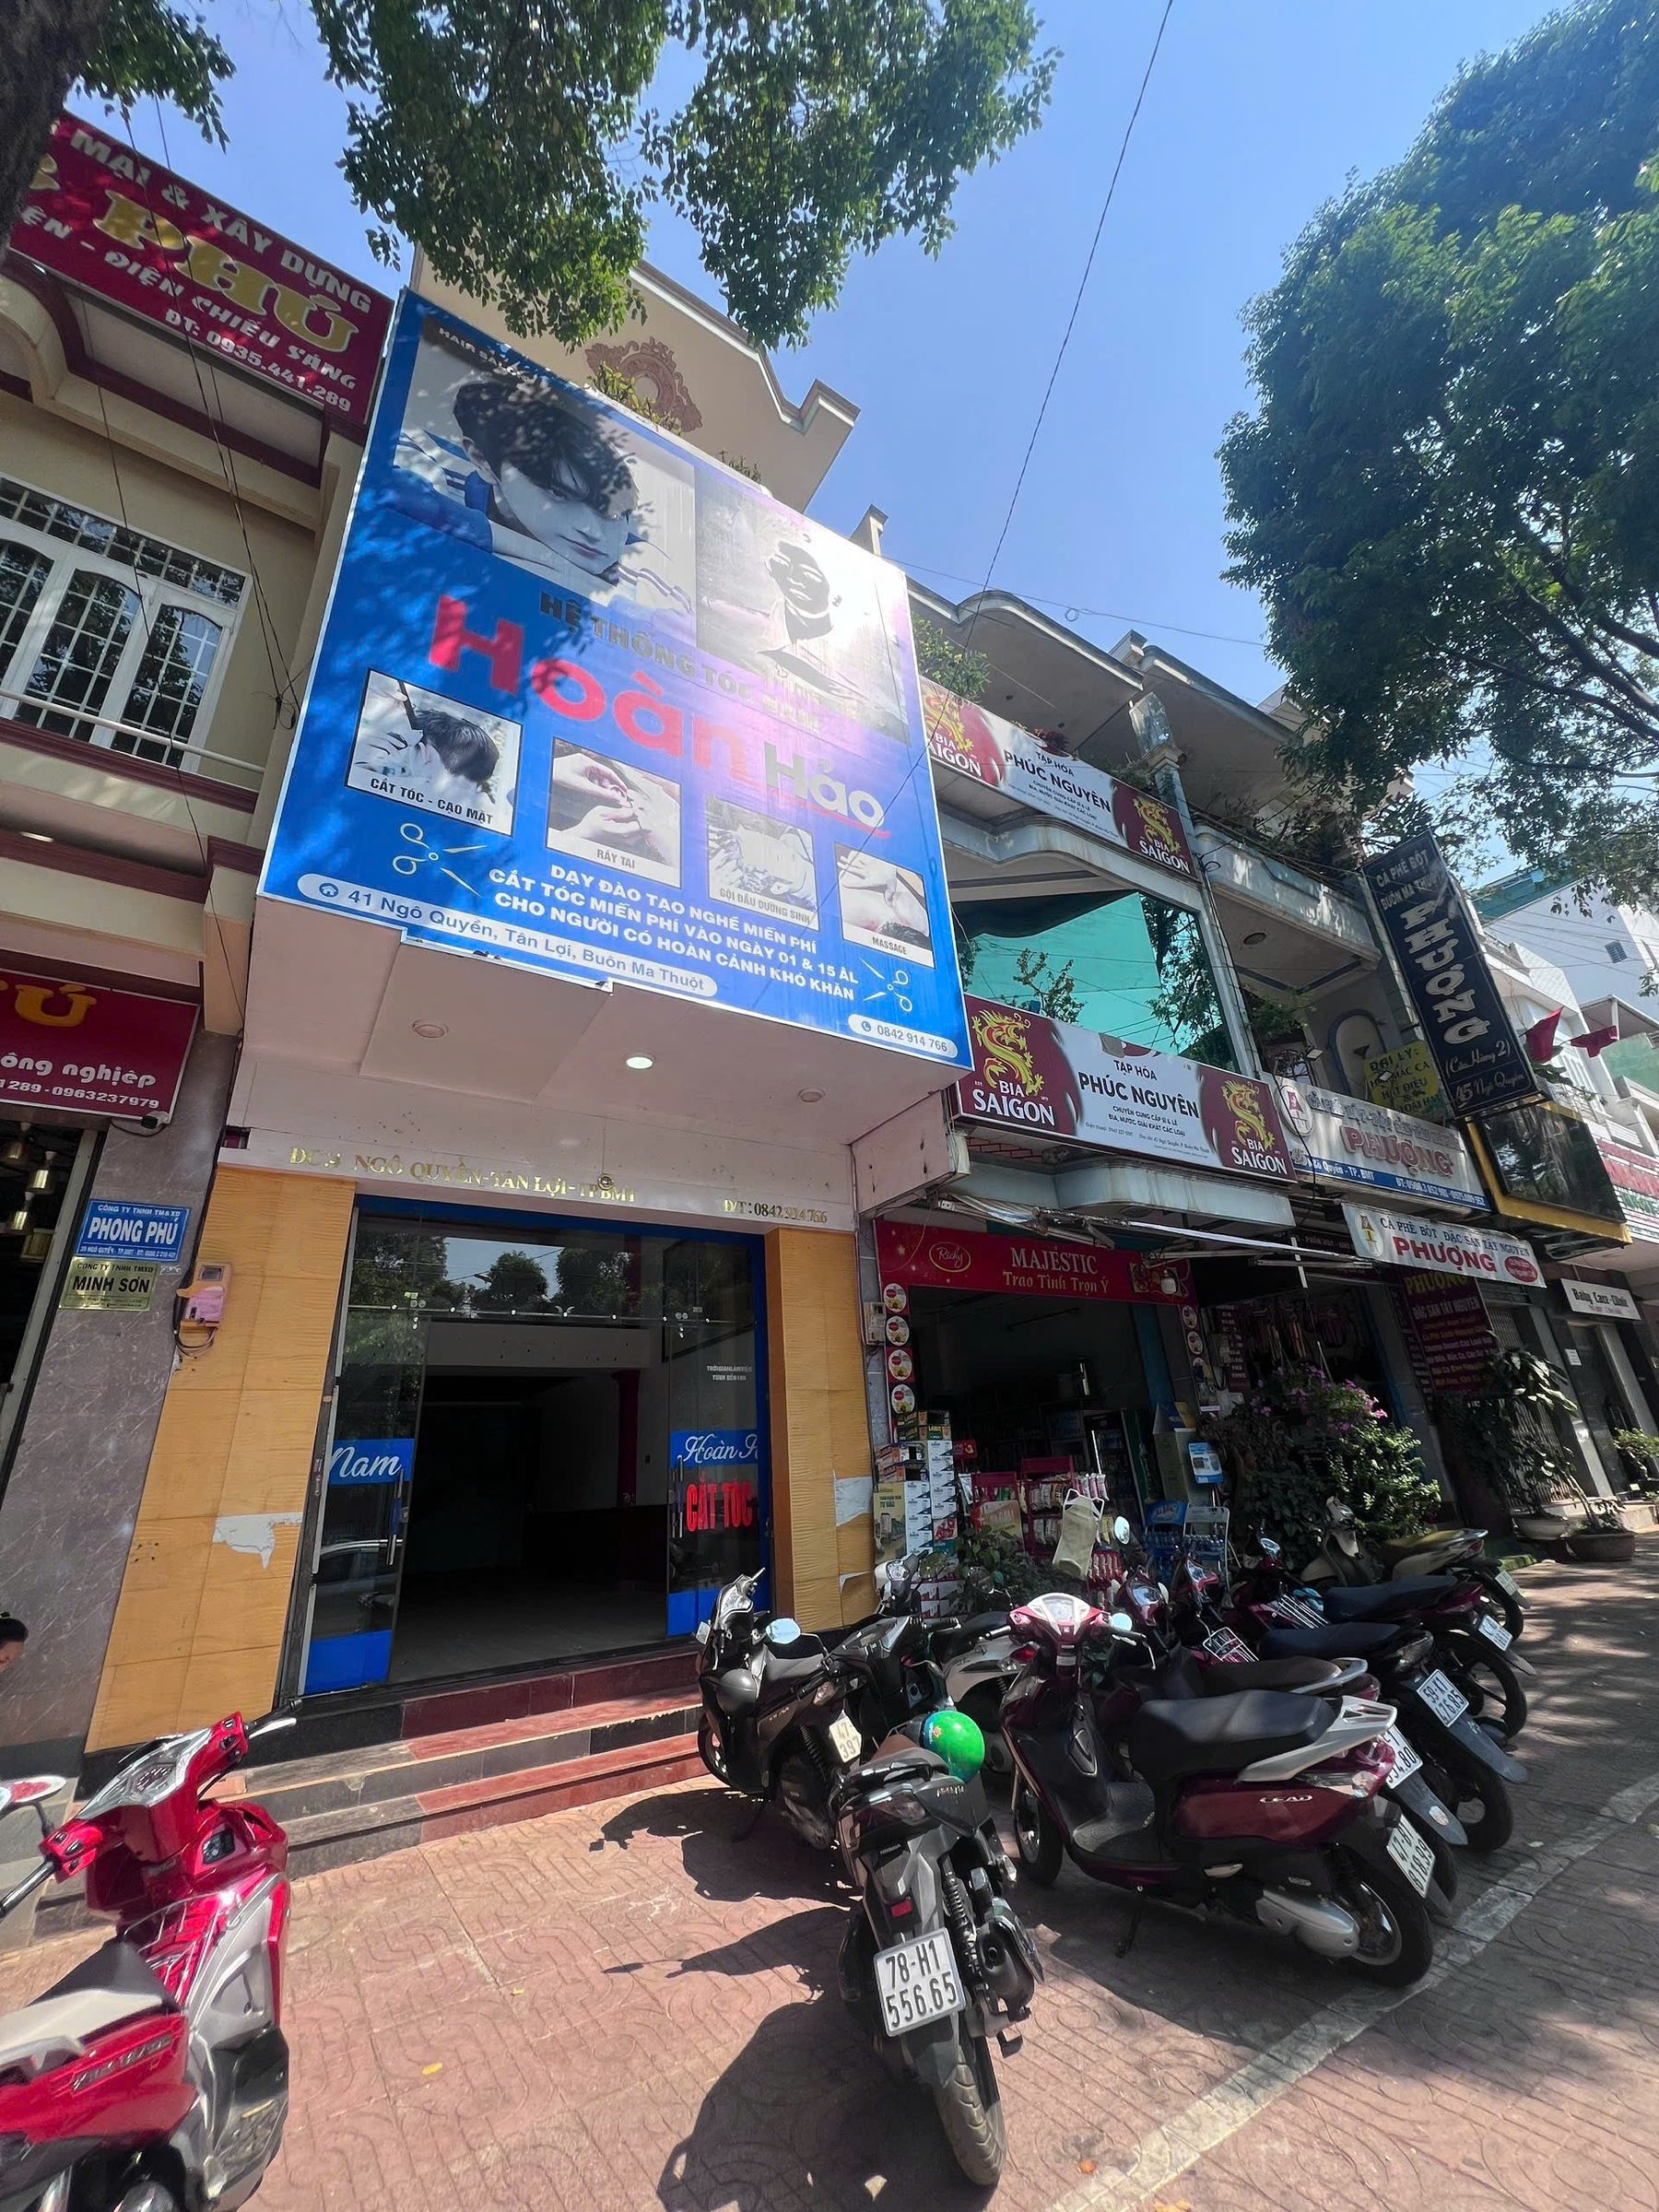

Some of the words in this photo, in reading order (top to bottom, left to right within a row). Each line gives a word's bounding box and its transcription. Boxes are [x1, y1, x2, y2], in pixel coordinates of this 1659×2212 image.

[69, 128, 152, 186] MẠI
[161, 184, 190, 210] &
[200, 202, 274, 254] XÂY
[280, 249, 371, 313] DỰNG
[93, 189, 359, 353] PHÚ
[104, 250, 184, 296] ĐIỆN
[192, 296, 280, 348] CHIẾU
[287, 344, 357, 390] SÁNG
[438, 327, 476, 354] HAIR
[205, 331, 352, 412] 0935.441.289
[540, 591, 584, 636] HỆ
[592, 614, 695, 678] THỐNG
[429, 594, 753, 785] Hoàn
[764, 740, 886, 829] Hảo
[935, 732, 956, 751] BIA
[928, 740, 982, 778] AIGON
[1036, 751, 1053, 765] TẠP
[1053, 759, 1075, 777] HÓA
[1004, 749, 1048, 782] PHÚC
[1050, 772, 1112, 813] NGUYÊN
[370, 776, 397, 795] CẮT
[399, 784, 425, 804] TÓC
[437, 798, 463, 818] CẠO
[466, 806, 494, 825] MẶT
[596, 848, 618, 864] RÁY
[619, 853, 636, 870] TAI
[1138, 839, 1191, 876] SAIGON
[1153, 838, 1170, 853] BIA
[1390, 858, 1409, 879] PHÊ
[550, 864, 594, 888] DẠY
[597, 873, 641, 901] ĐÀO
[646, 892, 686, 916] TẠO
[689, 903, 740, 932] NGHỀ
[790, 935, 818, 955] PHÍ
[789, 905, 811, 923] SINH
[347, 889, 372, 908] 41
[381, 896, 423, 920] Ngô
[429, 909, 499, 939] Quyền,
[505, 928, 538, 948] Tân
[545, 937, 578, 960] Lợi,
[582, 948, 627, 971] Buôn
[631, 961, 655, 978] Ma
[661, 967, 705, 993] Thuột
[488, 867, 536, 892] CẮT
[541, 878, 585, 907] TÓC
[646, 911, 679, 935] PHÍ
[683, 922, 724, 946] VÀO
[726, 930, 776, 959] NGÀY
[778, 949, 798, 968] 01
[801, 957, 815, 971] &
[818, 960, 837, 978] 15
[839, 964, 859, 985] ÂL
[494, 892, 547, 917] CHO
[549, 905, 618, 938] NGƯỜI
[623, 925, 653, 947] CÓ
[656, 935, 712, 964] HOÀN
[715, 947, 767, 979] CẢNH
[769, 964, 808, 986] KHÓ
[809, 972, 855, 1002] KHĂN
[871, 935, 908, 955] MASSAGE
[1400, 900, 1491, 1045] PHƯỢNG
[0, 982, 97, 1028] Ú
[877, 1025, 905, 1041] 0842
[907, 1031, 926, 1047] 914
[927, 1037, 948, 1053] 766
[62, 1061, 157, 1088] nghiệp
[1113, 1059, 1135, 1075] TẠP
[1135, 1063, 1158, 1082] HÓA
[7, 1080, 42, 1093] 289
[52, 1087, 159, 1110] 0963237979
[998, 1079, 1026, 1099] BIA
[1078, 1070, 1127, 1101] PHÚC
[1131, 1086, 1200, 1119] NGUYÊN
[1456, 1082, 1474, 1102] 45
[972, 1088, 1055, 1126] SAIGON
[1245, 1137, 1265, 1152] BIA
[1340, 1125, 1453, 1177] PHƯỢNG
[354, 1154, 404, 1175] NGÔ
[1232, 1146, 1288, 1176] SAIGON
[98, 1204, 120, 1213] CÔNG
[88, 1217, 144, 1243] PHONG
[145, 1217, 179, 1245] PHÚ
[1380, 1218, 1395, 1231] CÀ
[1396, 1218, 1418, 1234] PHÊ
[1392, 1235, 1498, 1273] PHƯỢNG
[72, 1276, 115, 1292] MINH
[118, 1277, 150, 1294] SƠN
[1002, 1271, 1034, 1289] Trao
[1037, 1274, 1067, 1292] Tình
[1070, 1277, 1099, 1295] Trọn
[1097, 1275, 1110, 1295] Ý
[1571, 1288, 1594, 1305] Baby
[1593, 1291, 1610, 1304] Care
[328, 1446, 403, 1479] Nam
[683, 1434, 738, 1464] Hoàn
[687, 1471, 717, 1532] CẮT
[886, 1938, 941, 1990] 78-H1
[886, 1971, 958, 2029] 556.65
